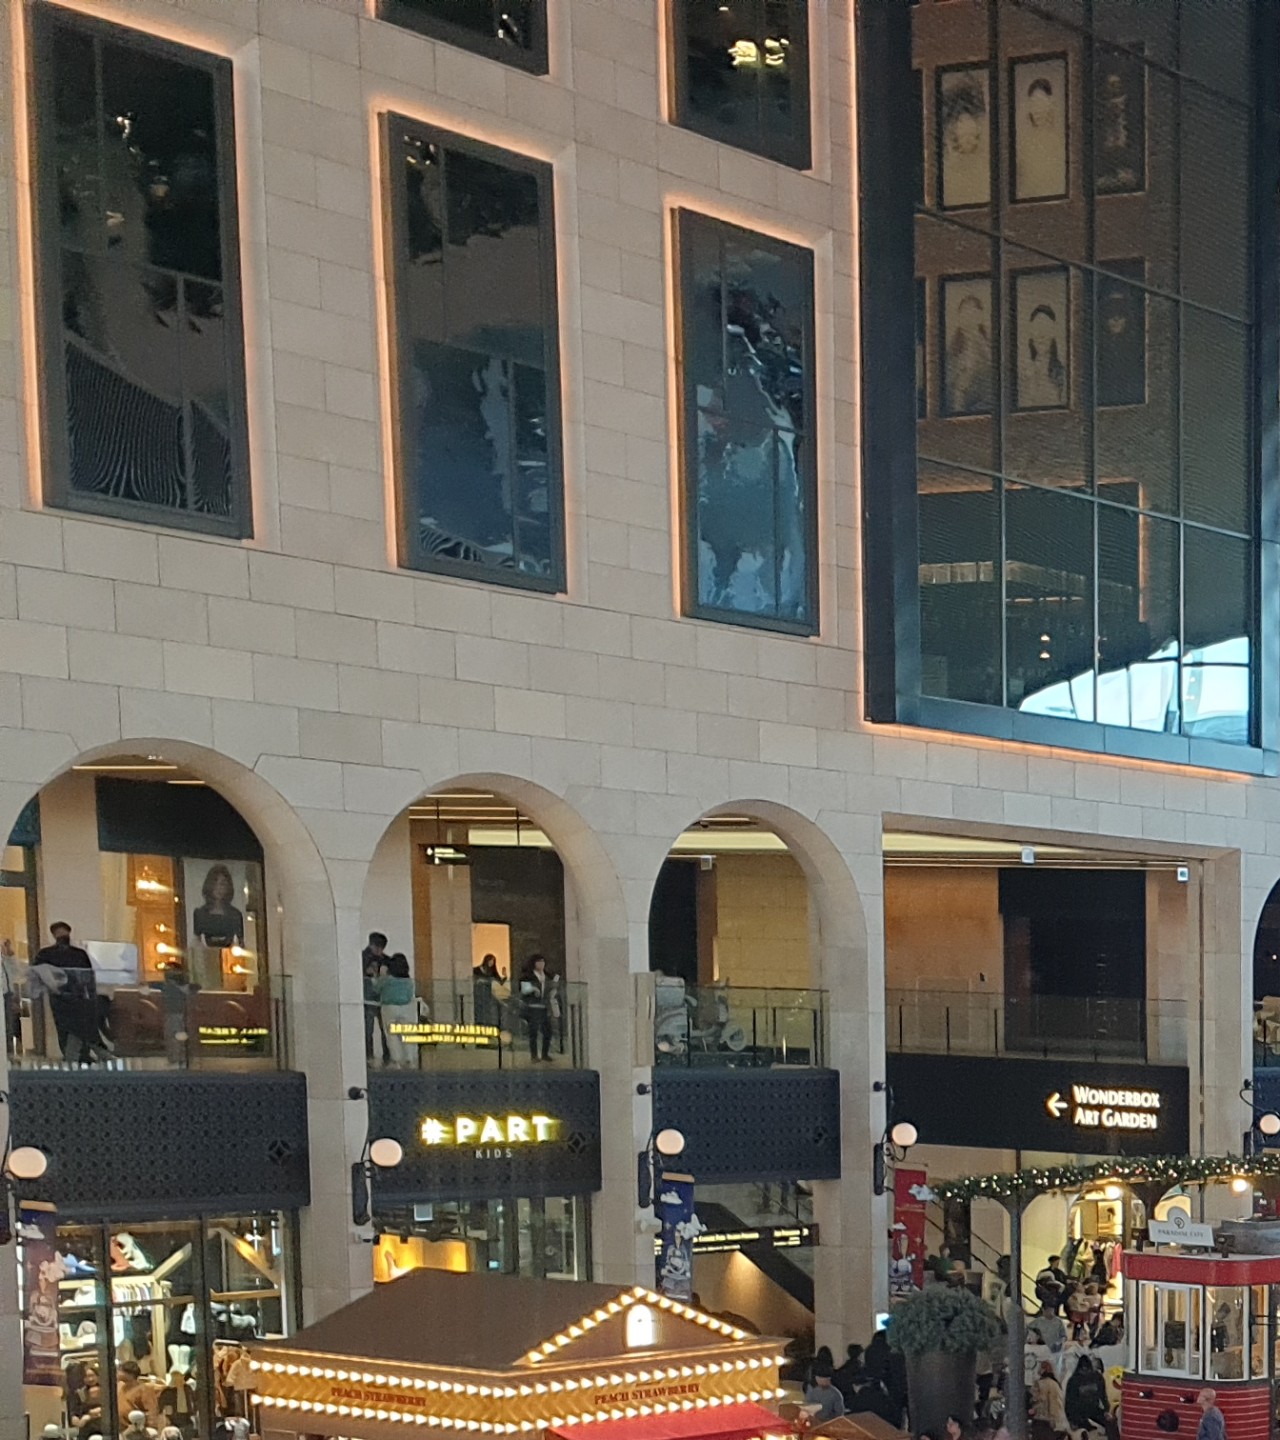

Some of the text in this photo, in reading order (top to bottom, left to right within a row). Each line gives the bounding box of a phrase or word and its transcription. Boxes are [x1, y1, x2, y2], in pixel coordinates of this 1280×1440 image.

[1072, 1085, 1160, 1108] WONDERBOX
[1074, 1106, 1157, 1129] ART GARDEN
[456, 1115, 553, 1145] PART
[475, 1149, 513, 1159] KIDS
[594, 1383, 701, 1405] PEACH STRAWBERRY
